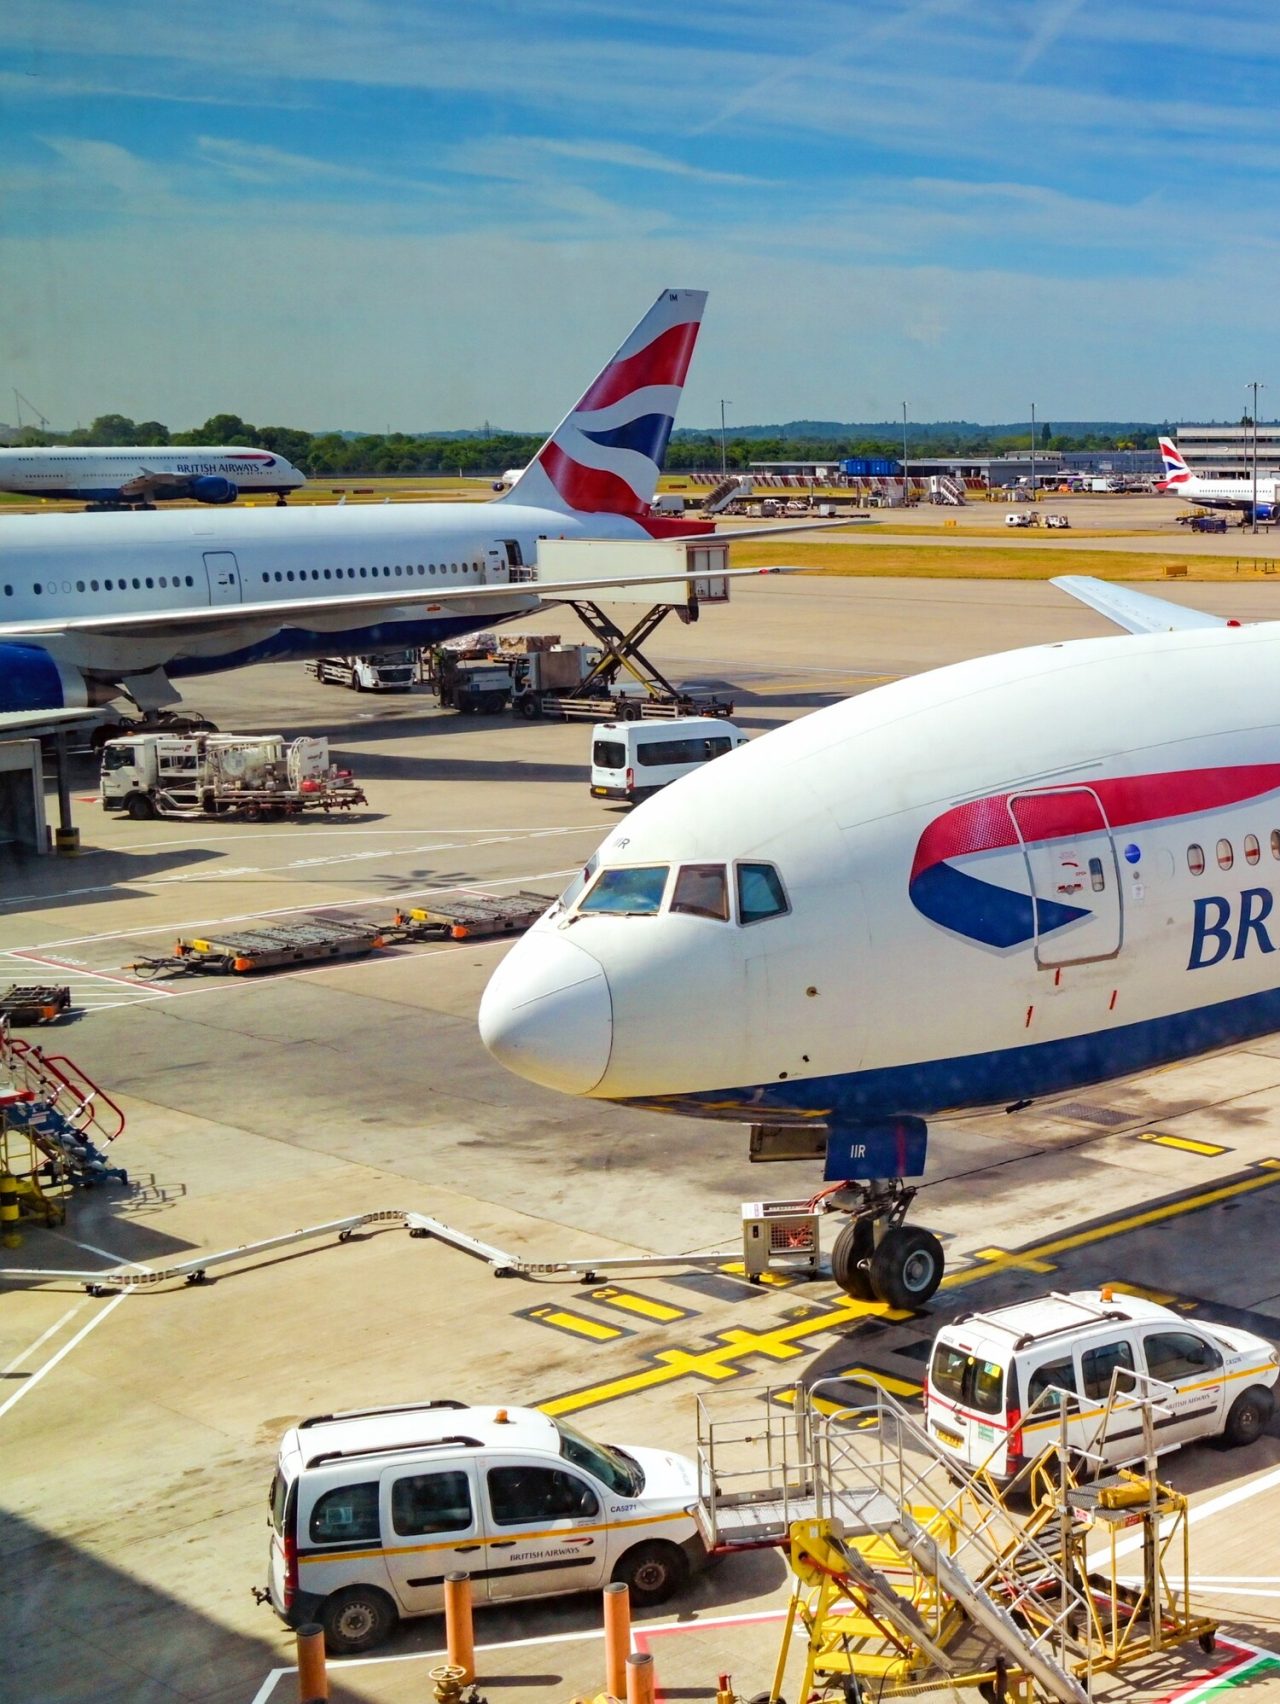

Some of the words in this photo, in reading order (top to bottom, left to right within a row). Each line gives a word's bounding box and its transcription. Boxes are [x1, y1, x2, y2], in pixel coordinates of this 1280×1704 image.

[177, 463, 217, 473] BRITISH
[218, 463, 260, 473] AIRWAYS
[610, 1504, 637, 1513] CA5271
[510, 1551, 543, 1561] BRITISH
[544, 1547, 580, 1557] AIRWAYS
